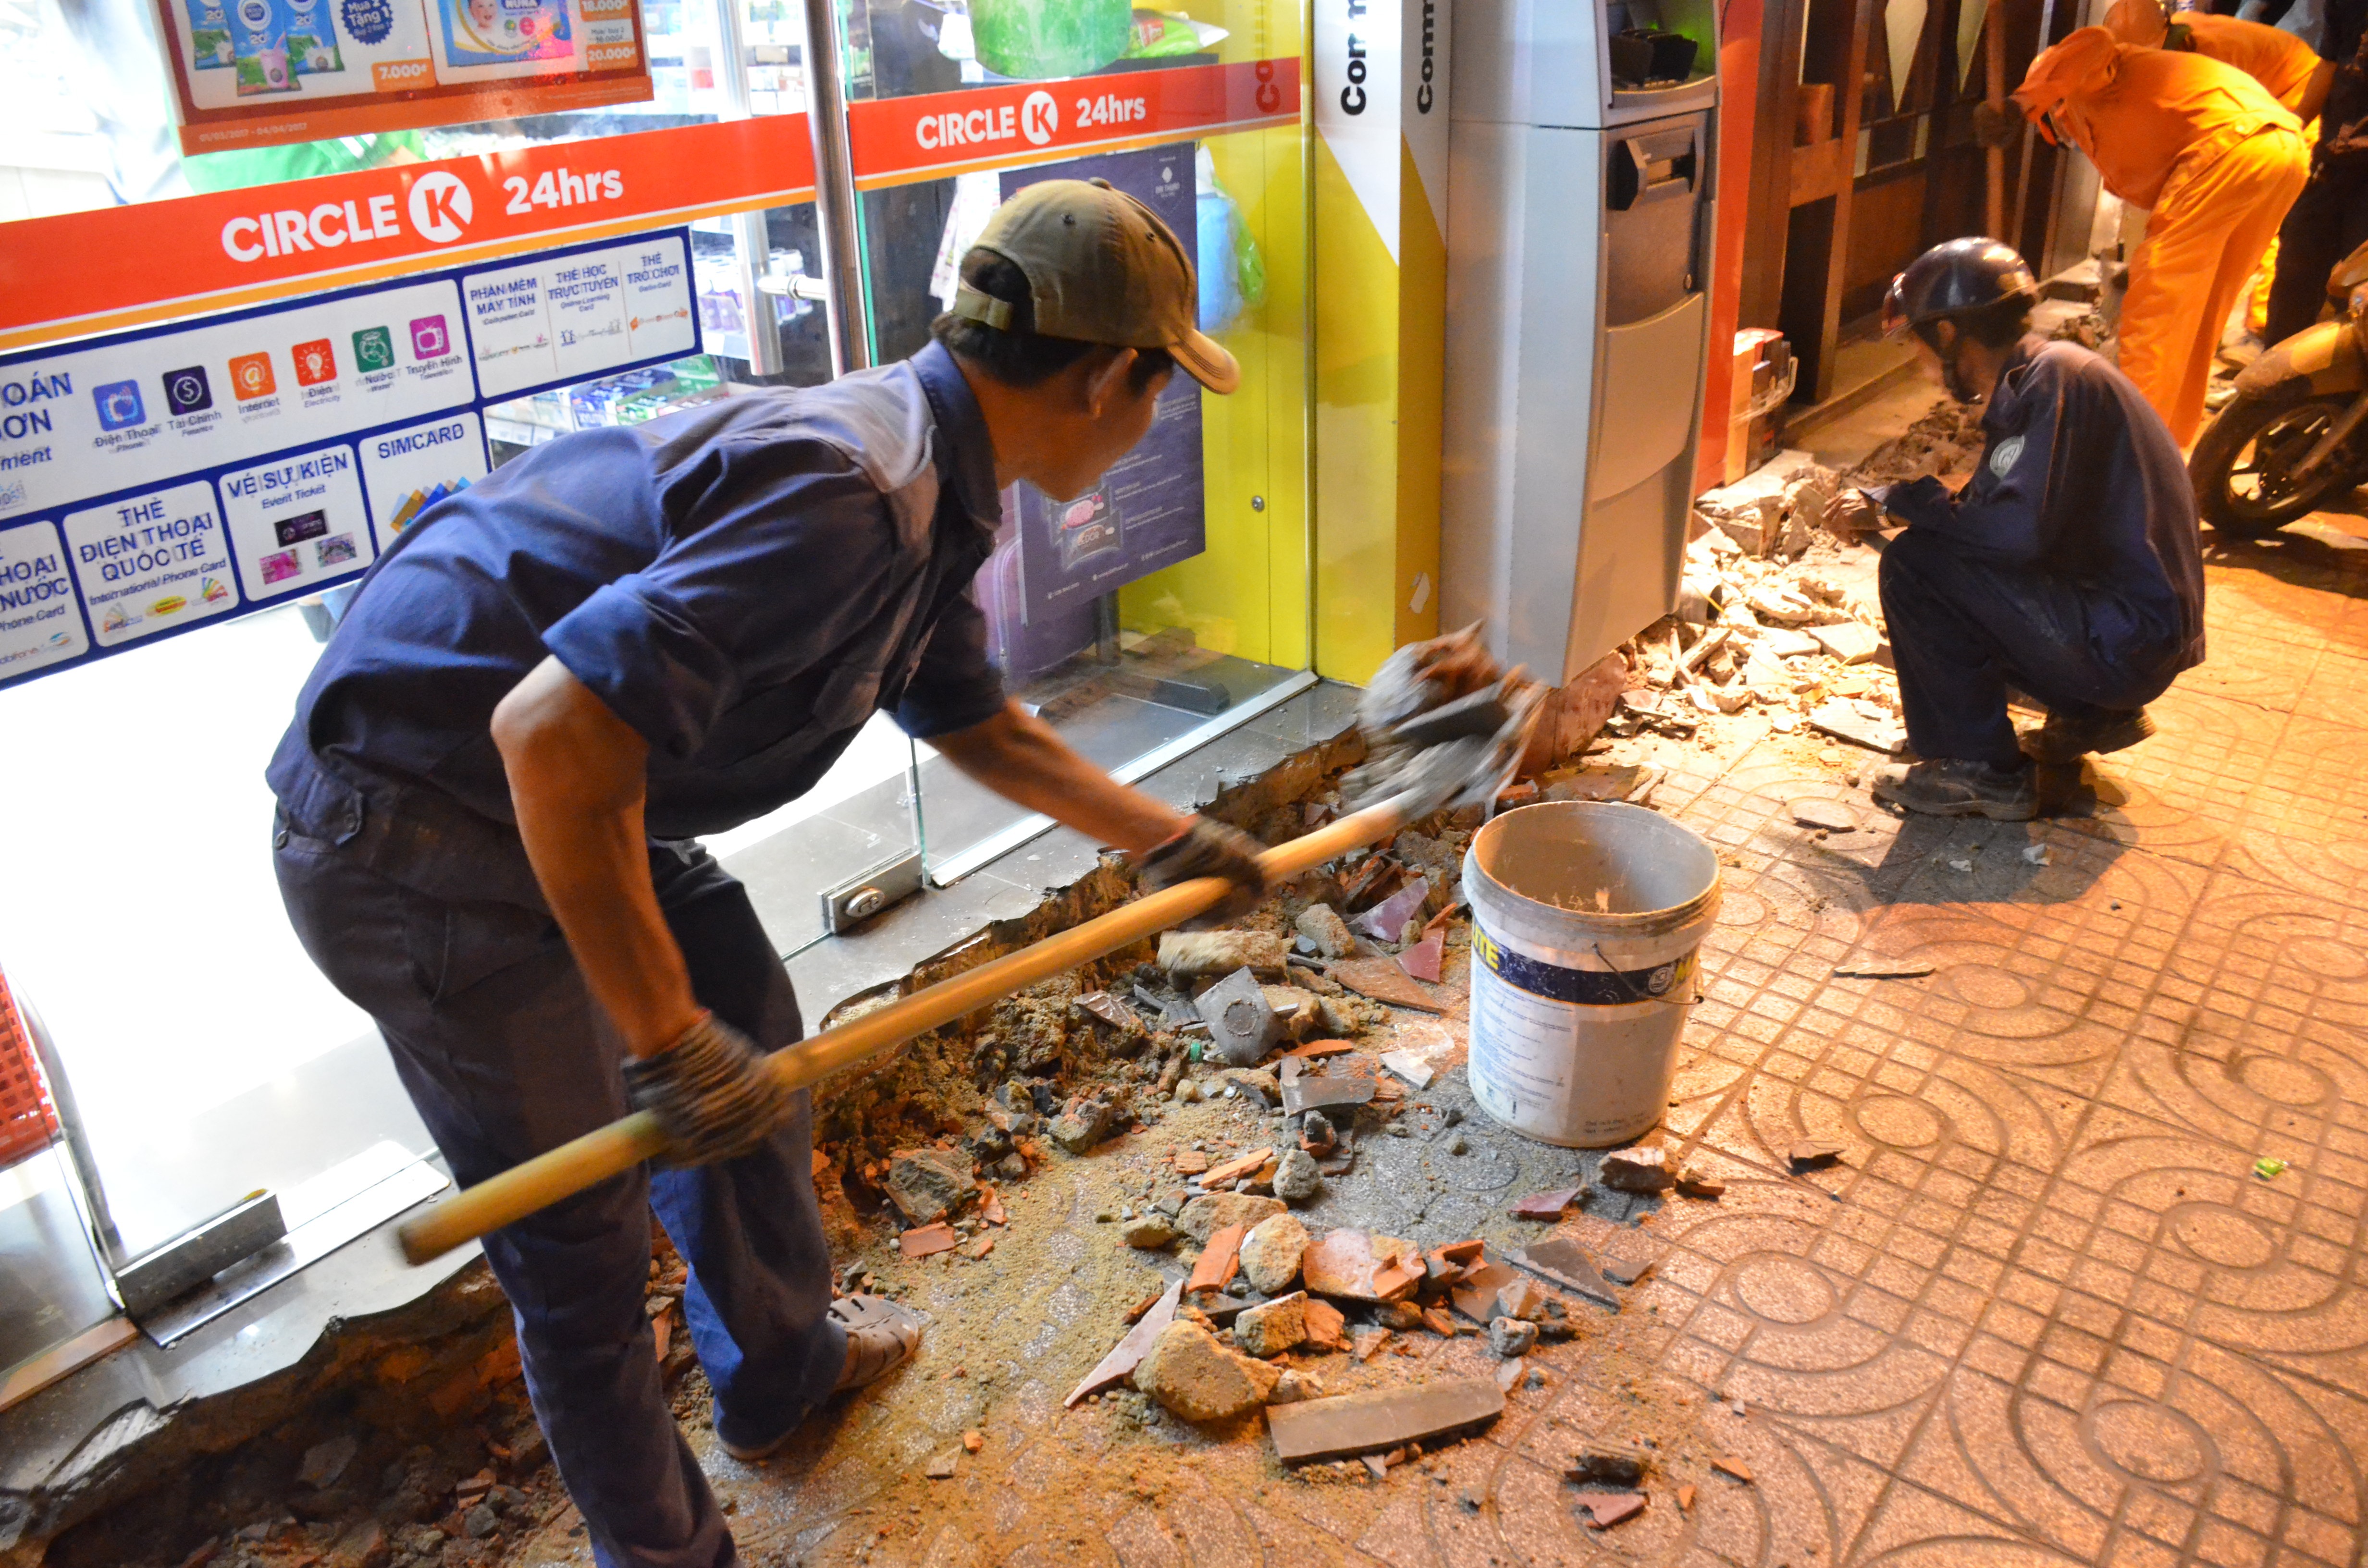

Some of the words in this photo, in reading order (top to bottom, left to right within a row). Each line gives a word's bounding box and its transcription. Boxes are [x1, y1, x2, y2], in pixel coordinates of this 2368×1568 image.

[916, 105, 1016, 150] CIRCLE
[1076, 94, 1147, 128] 24hrs
[221, 194, 401, 263] CIRCLE
[503, 169, 624, 216] 24hrs
[2, 370, 73, 406] OÁN
[0, 409, 53, 439] ƠN
[378, 423, 464, 459] SIMCARD
[300, 452, 348, 478] KIỆN
[261, 493, 293, 510] Event
[295, 484, 326, 500] Ticket
[80, 532, 138, 564] ĐIỆN
[142, 512, 213, 546] THOẠI
[89, 576, 161, 606] International
[162, 568, 198, 585] Phone
[200, 557, 226, 574] Card
[37, 603, 65, 621] Card
